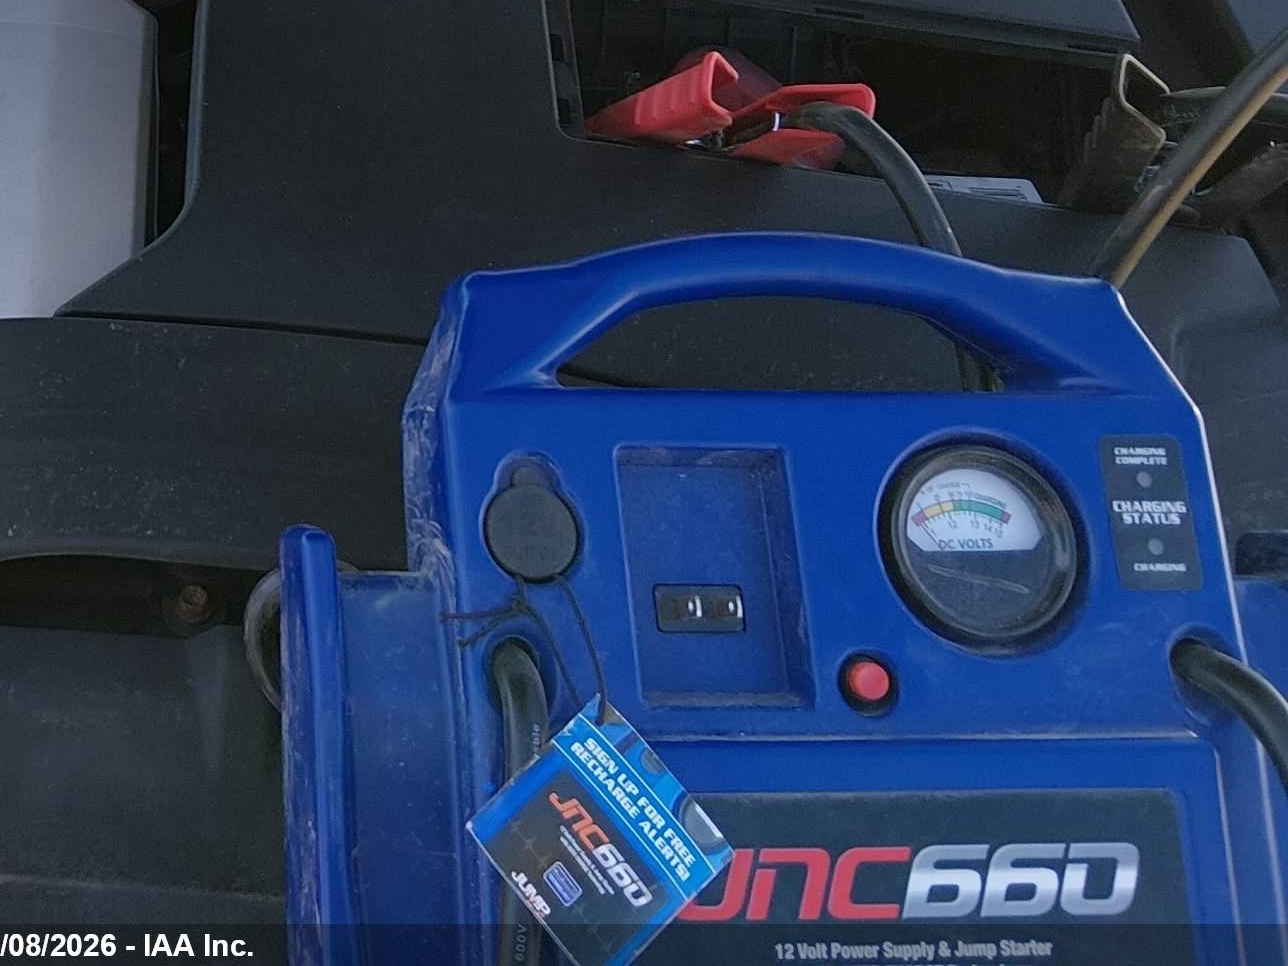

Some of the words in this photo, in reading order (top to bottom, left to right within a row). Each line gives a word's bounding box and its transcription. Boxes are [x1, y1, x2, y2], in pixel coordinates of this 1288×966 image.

[1114, 447, 1166, 456] CHARGING
[1115, 456, 1168, 465] COMPLETE
[1113, 500, 1187, 513] CHARGING
[1122, 513, 1181, 525] STATUS
[938, 540, 955, 550] DC
[958, 538, 994, 550] VOLTS
[1133, 563, 1187, 572] CHARGING
[584, 737, 619, 774] SIGN
[617, 769, 639, 795] UP
[637, 792, 666, 828] FOR
[663, 825, 696, 867] FREE
[570, 741, 640, 819] RECHARGE
[638, 816, 691, 882] ALERTS!
[548, 792, 654, 907] JNC660
[511, 870, 552, 916] JUMP
[774, 942, 795, 960] 12
[797, 942, 828, 960] Volt
[830, 942, 879, 959] Power
[883, 940, 936, 961] Supply
[939, 940, 952, 956] &
[954, 940, 998, 960] Jump
[999, 939, 1054, 956] Starter
